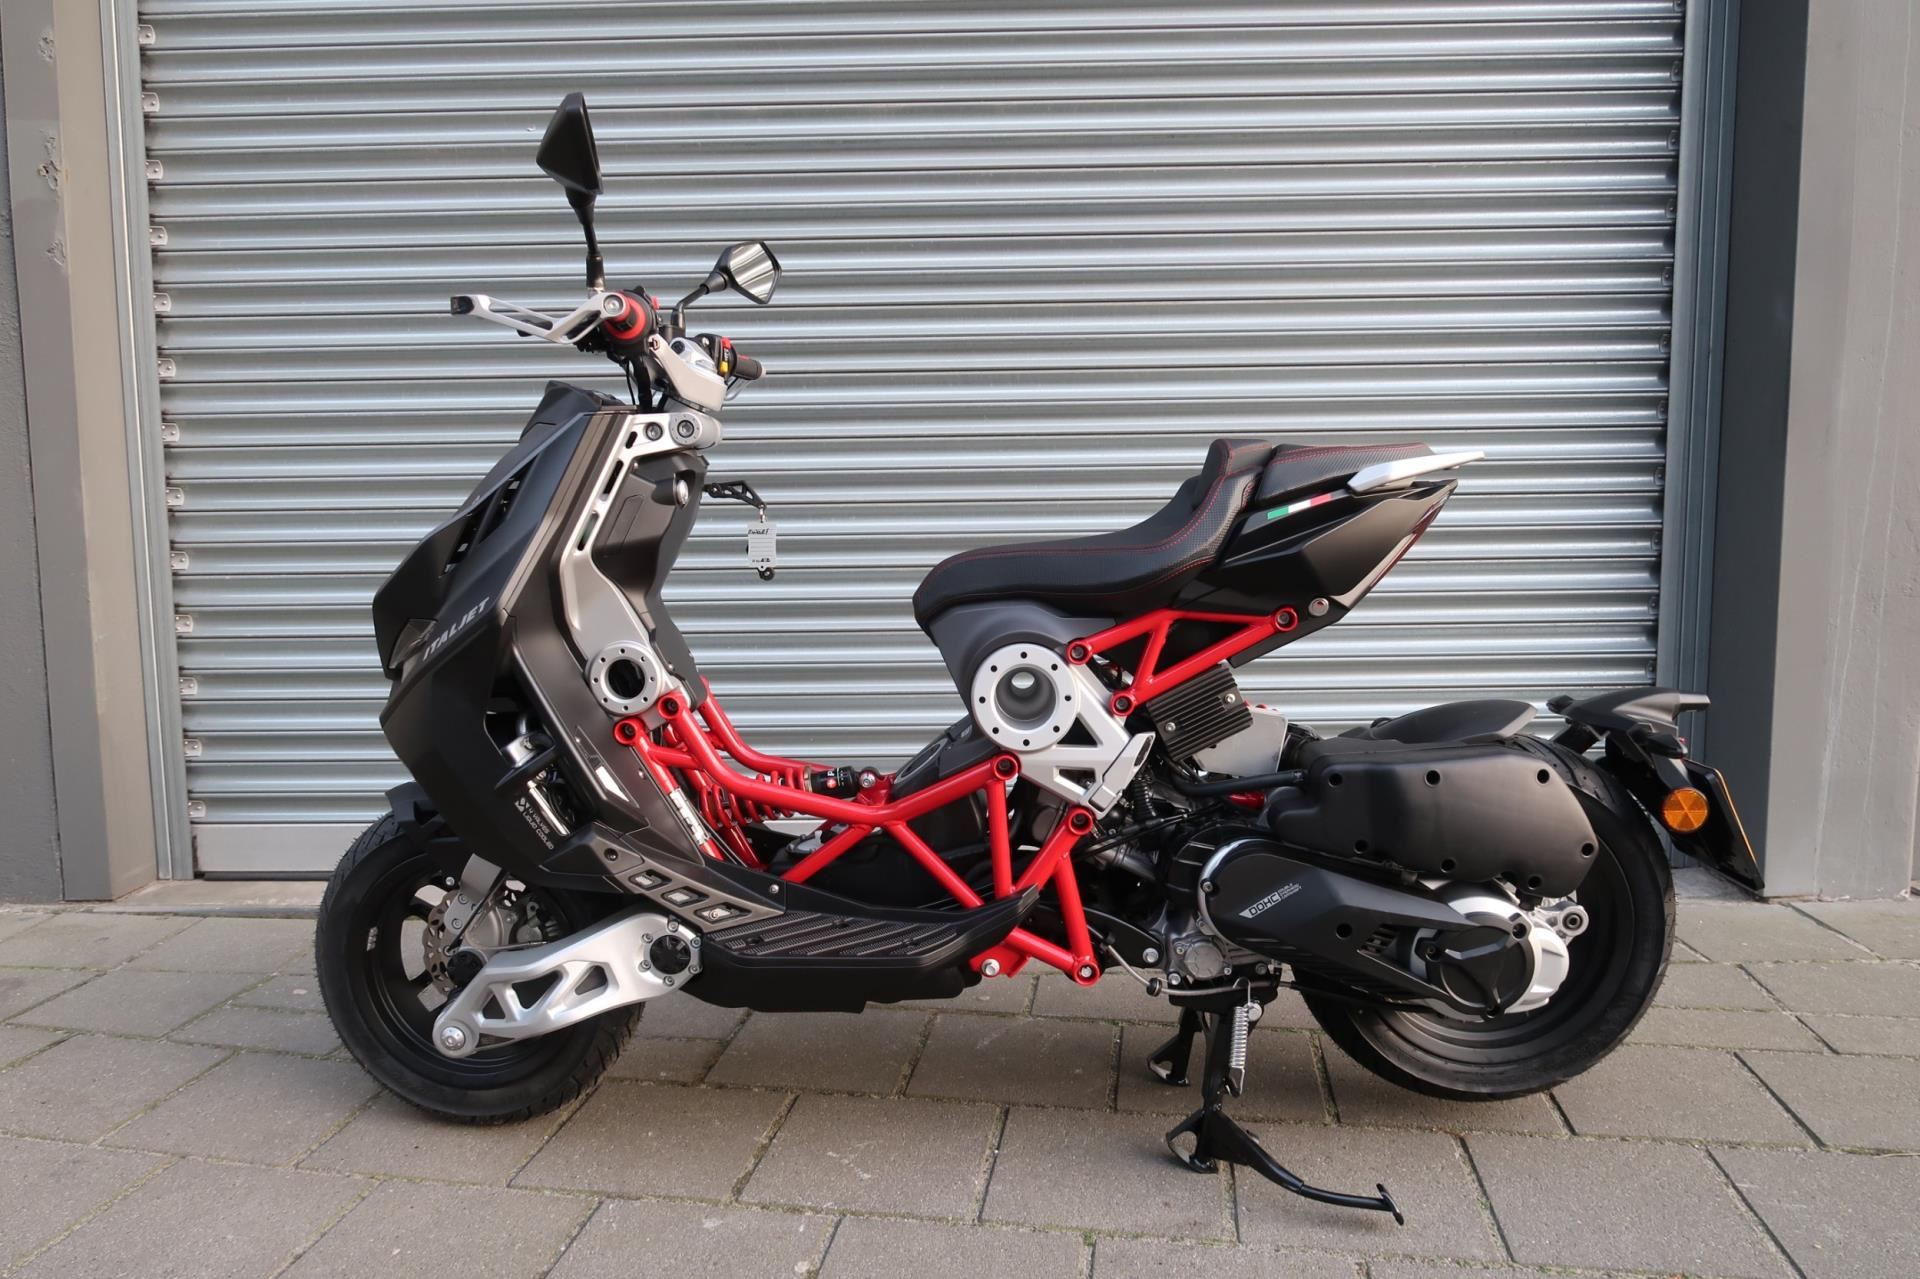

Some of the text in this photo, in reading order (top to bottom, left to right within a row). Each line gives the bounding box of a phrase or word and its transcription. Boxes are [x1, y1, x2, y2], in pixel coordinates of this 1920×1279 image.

[423, 596, 490, 662] ITALJET
[523, 812, 555, 850] LIQUID COOLED
[533, 811, 551, 835] VALVES
[1248, 892, 1280, 916] DOHC
